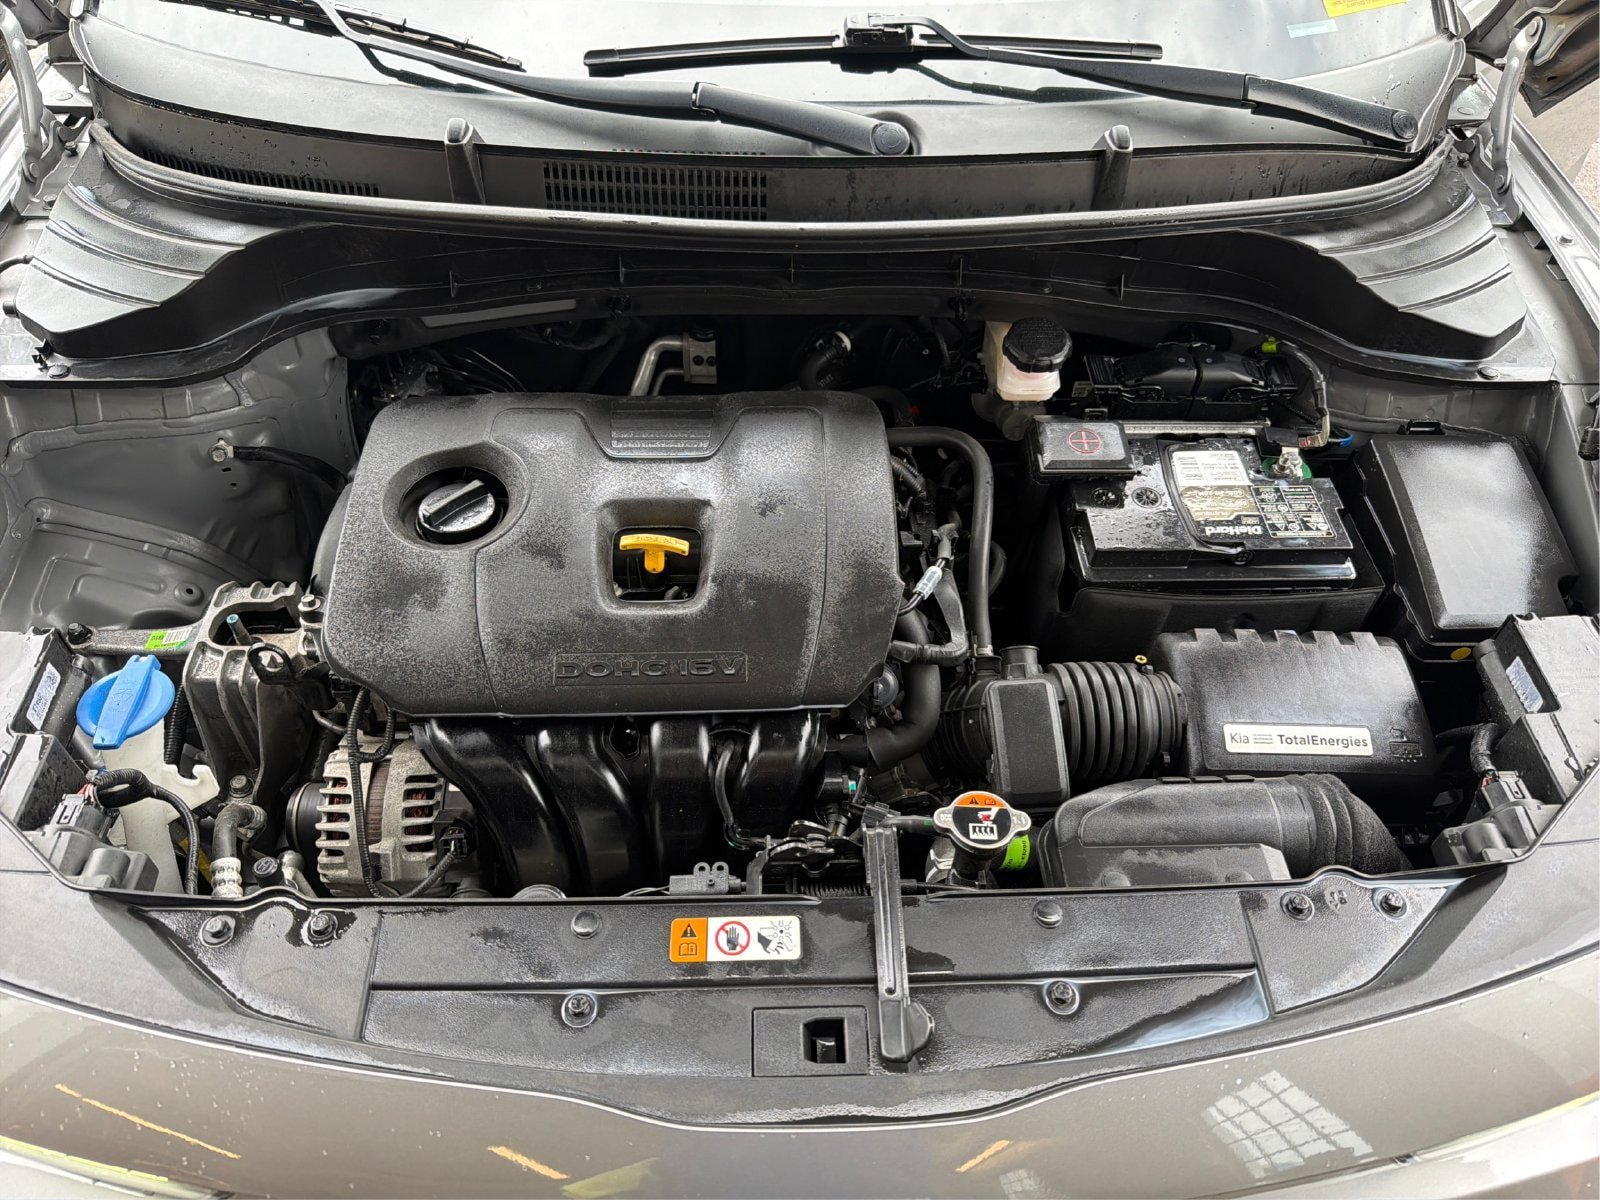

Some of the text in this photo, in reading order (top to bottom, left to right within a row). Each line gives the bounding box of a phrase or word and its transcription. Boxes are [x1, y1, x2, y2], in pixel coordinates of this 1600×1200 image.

[1204, 525, 1263, 535] DieHard
[556, 658, 744, 678] DOHC 16V
[1230, 733, 1368, 748] Kia TotalEnergies
